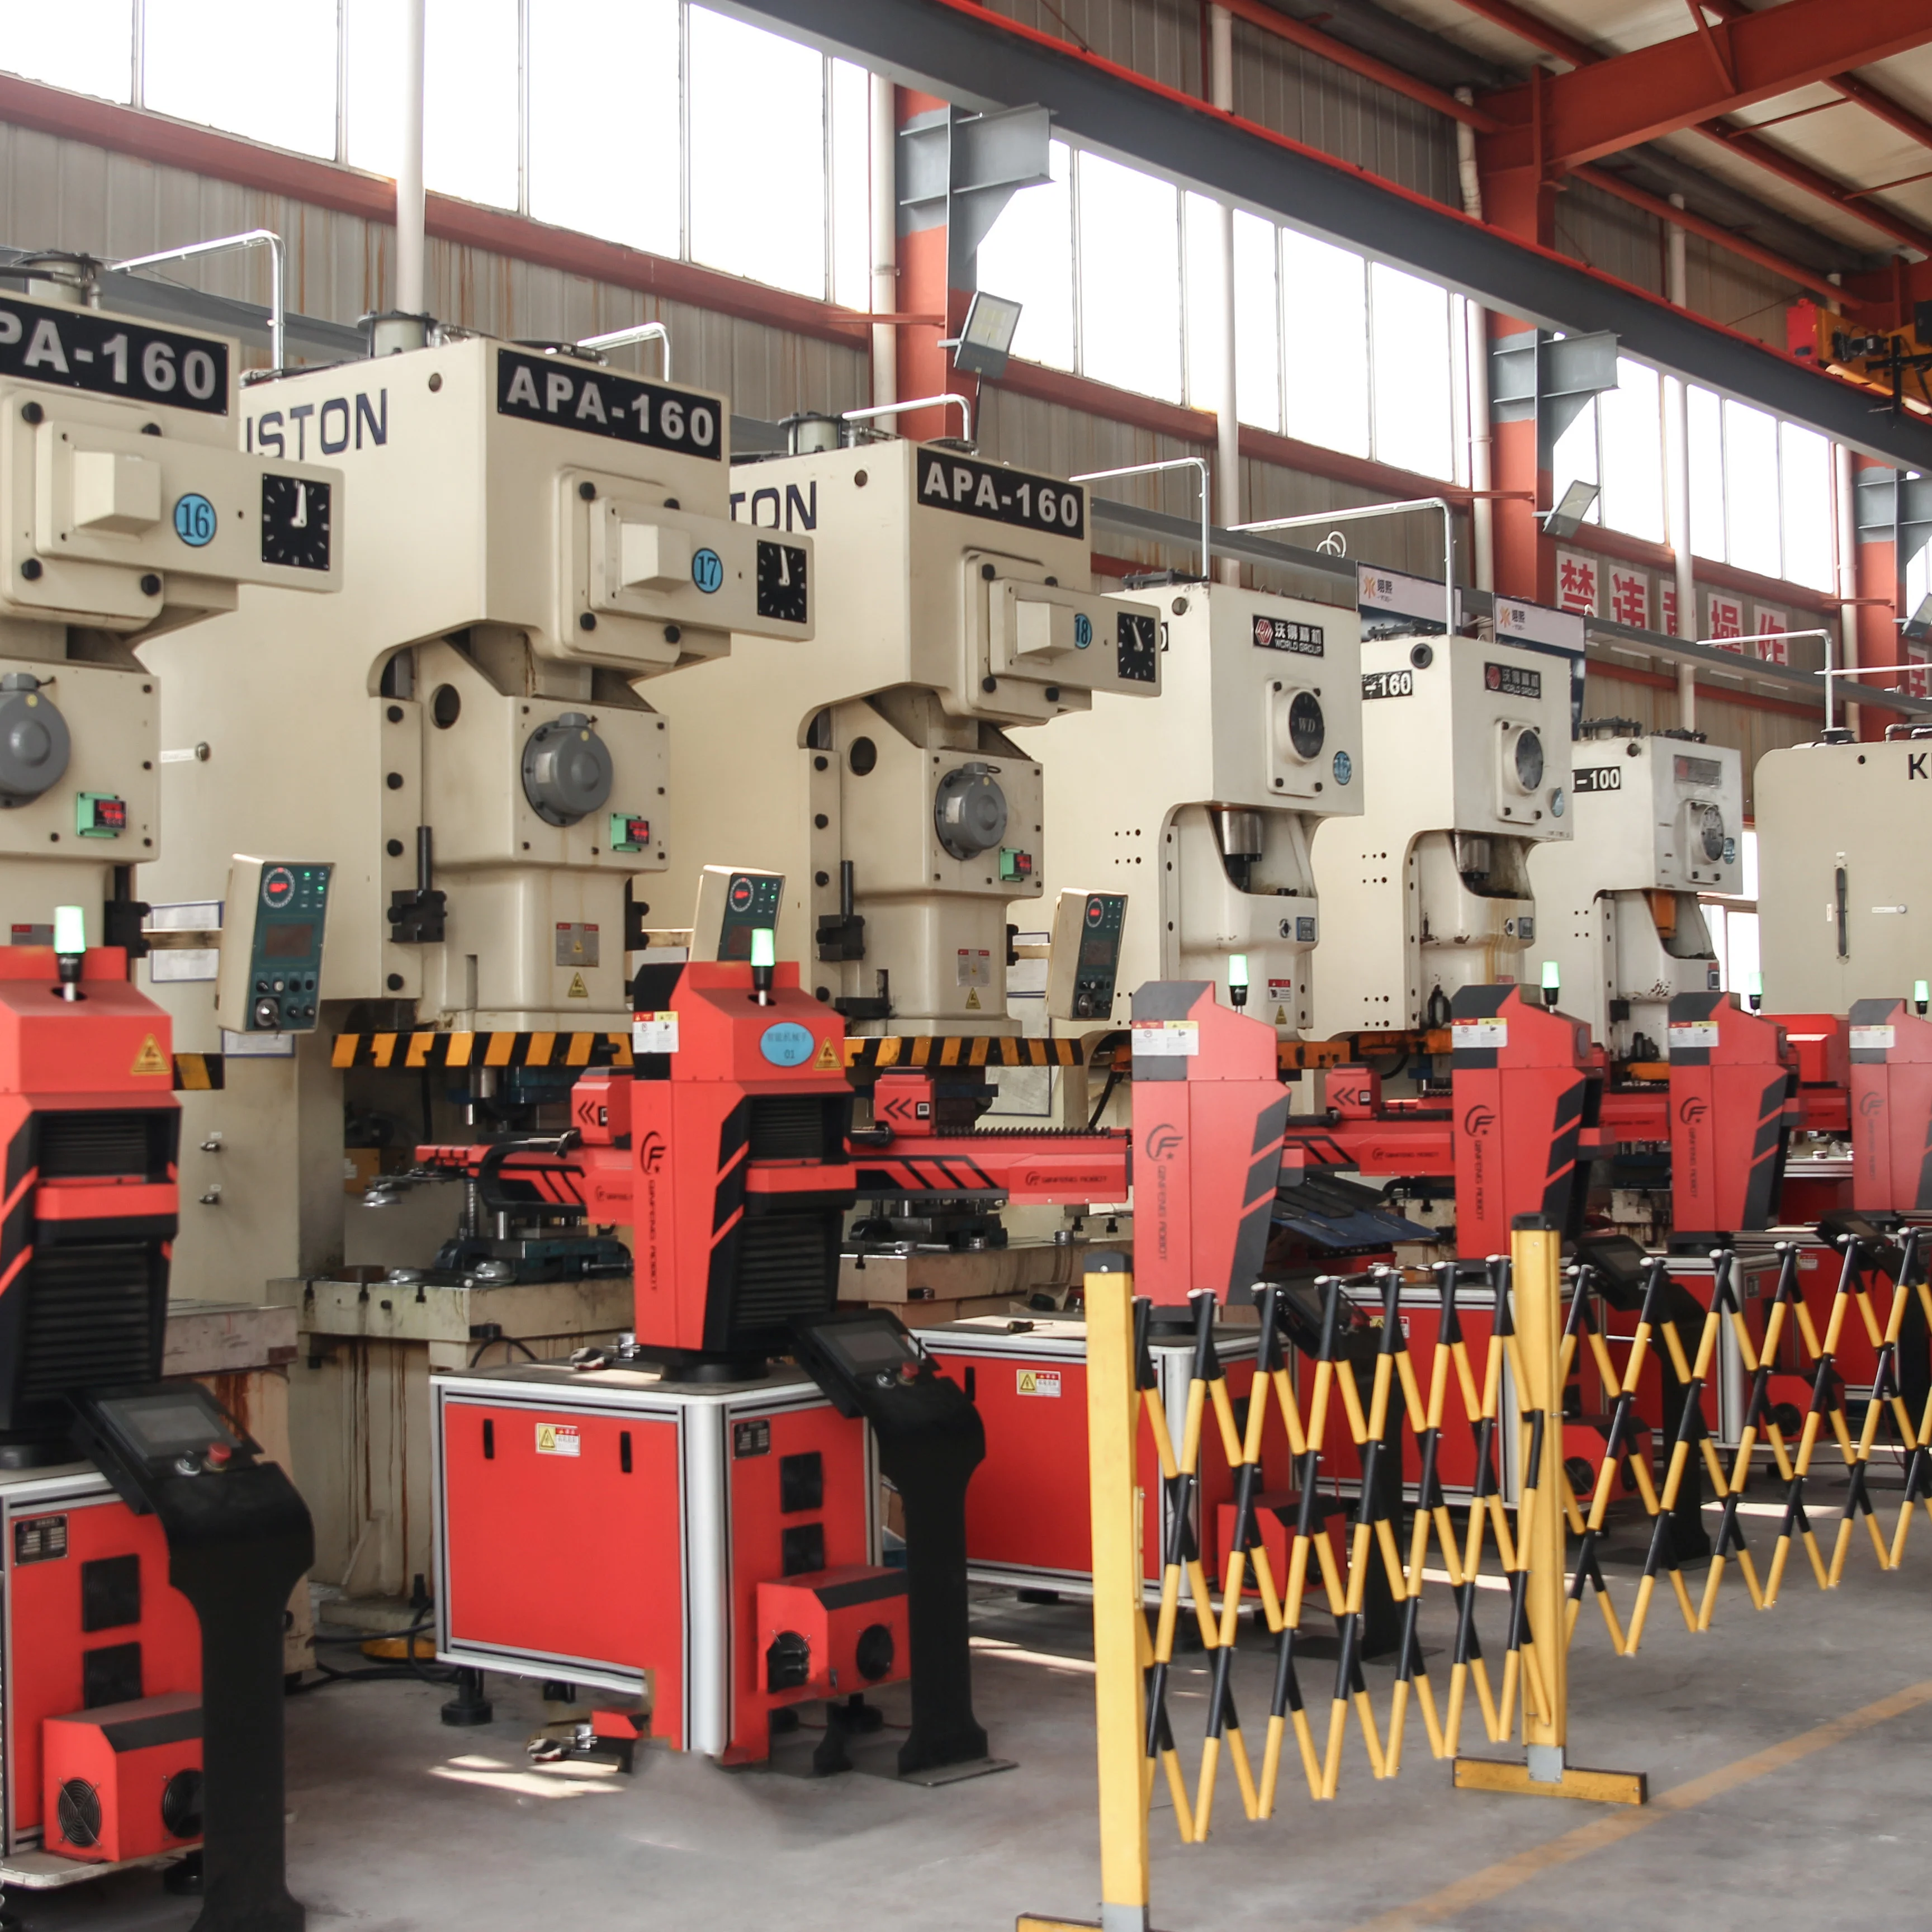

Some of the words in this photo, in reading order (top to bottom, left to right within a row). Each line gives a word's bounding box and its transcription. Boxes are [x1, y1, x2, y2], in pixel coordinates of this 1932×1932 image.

[506, 366, 714, 447] APA-160
[924, 461, 1078, 528] APA-160
[181, 503, 211, 538] 16
[697, 555, 718, 587] 17
[1075, 618, 1088, 645] 18
[1275, 638, 1298, 651] WORLD
[1299, 642, 1322, 654] GROUP
[784, 1049, 795, 1059] 01
[1158, 1221, 1168, 1262] ROBOT
